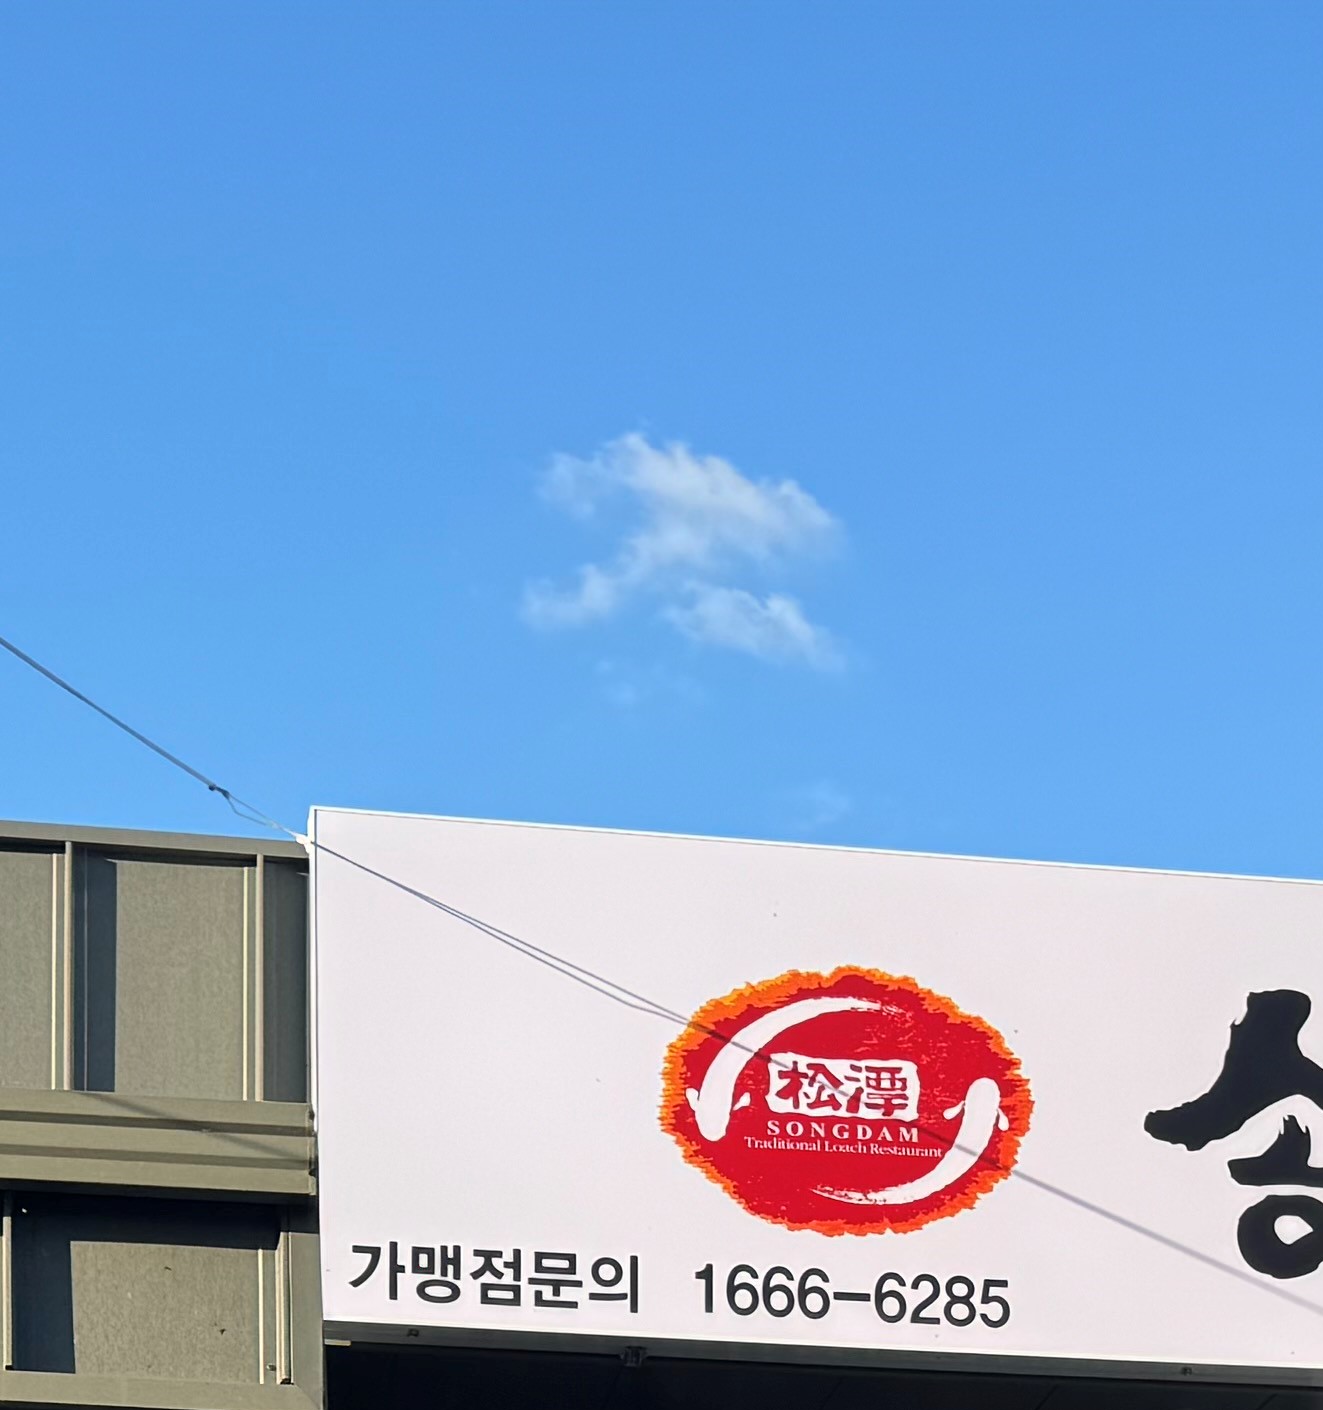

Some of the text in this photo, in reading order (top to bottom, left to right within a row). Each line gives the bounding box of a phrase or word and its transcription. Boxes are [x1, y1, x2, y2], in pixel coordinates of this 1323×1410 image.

[767, 1120, 920, 1143] SONGDAM
[744, 1136, 943, 1158] Traditional Loach Restaurant
[349, 1241, 1011, 1328] 가맹점문의 1666-6285
